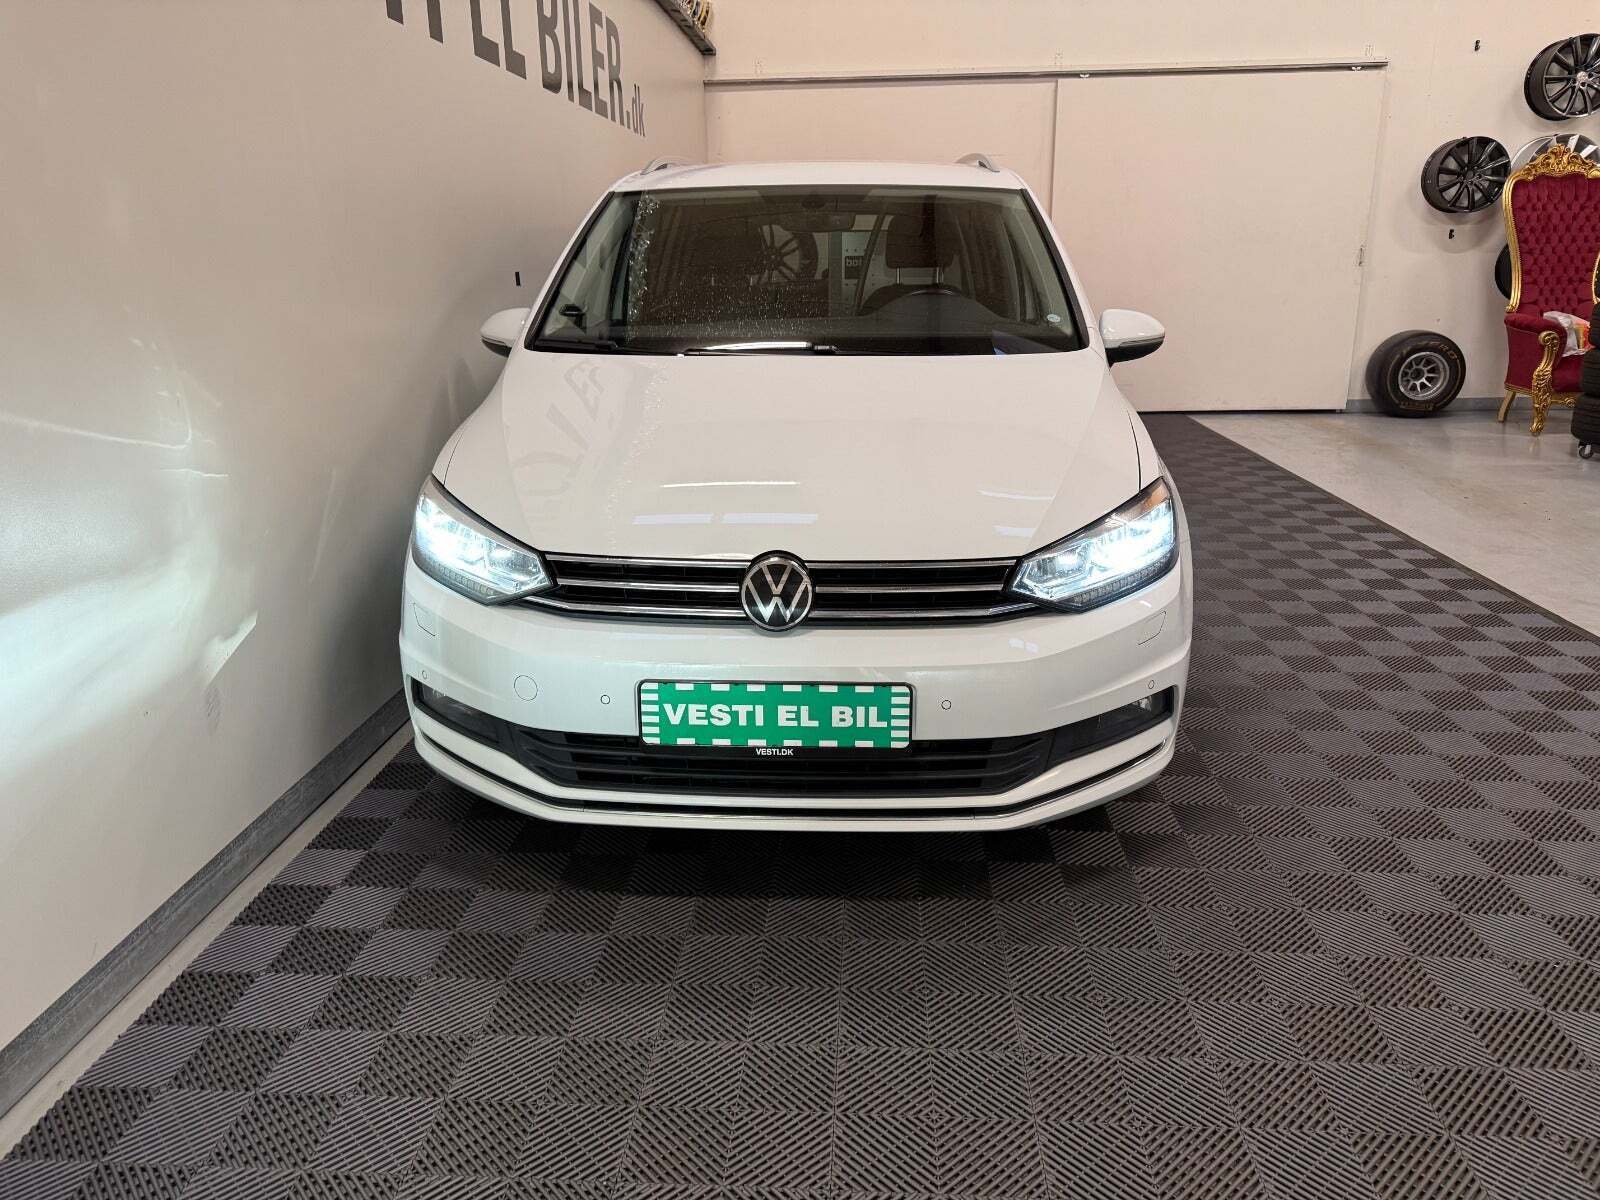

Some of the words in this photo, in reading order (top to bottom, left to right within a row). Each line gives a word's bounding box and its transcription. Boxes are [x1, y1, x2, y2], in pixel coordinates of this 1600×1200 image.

[663, 703, 764, 726] VESTI
[777, 705, 819, 727] EL
[831, 706, 888, 728] BIL
